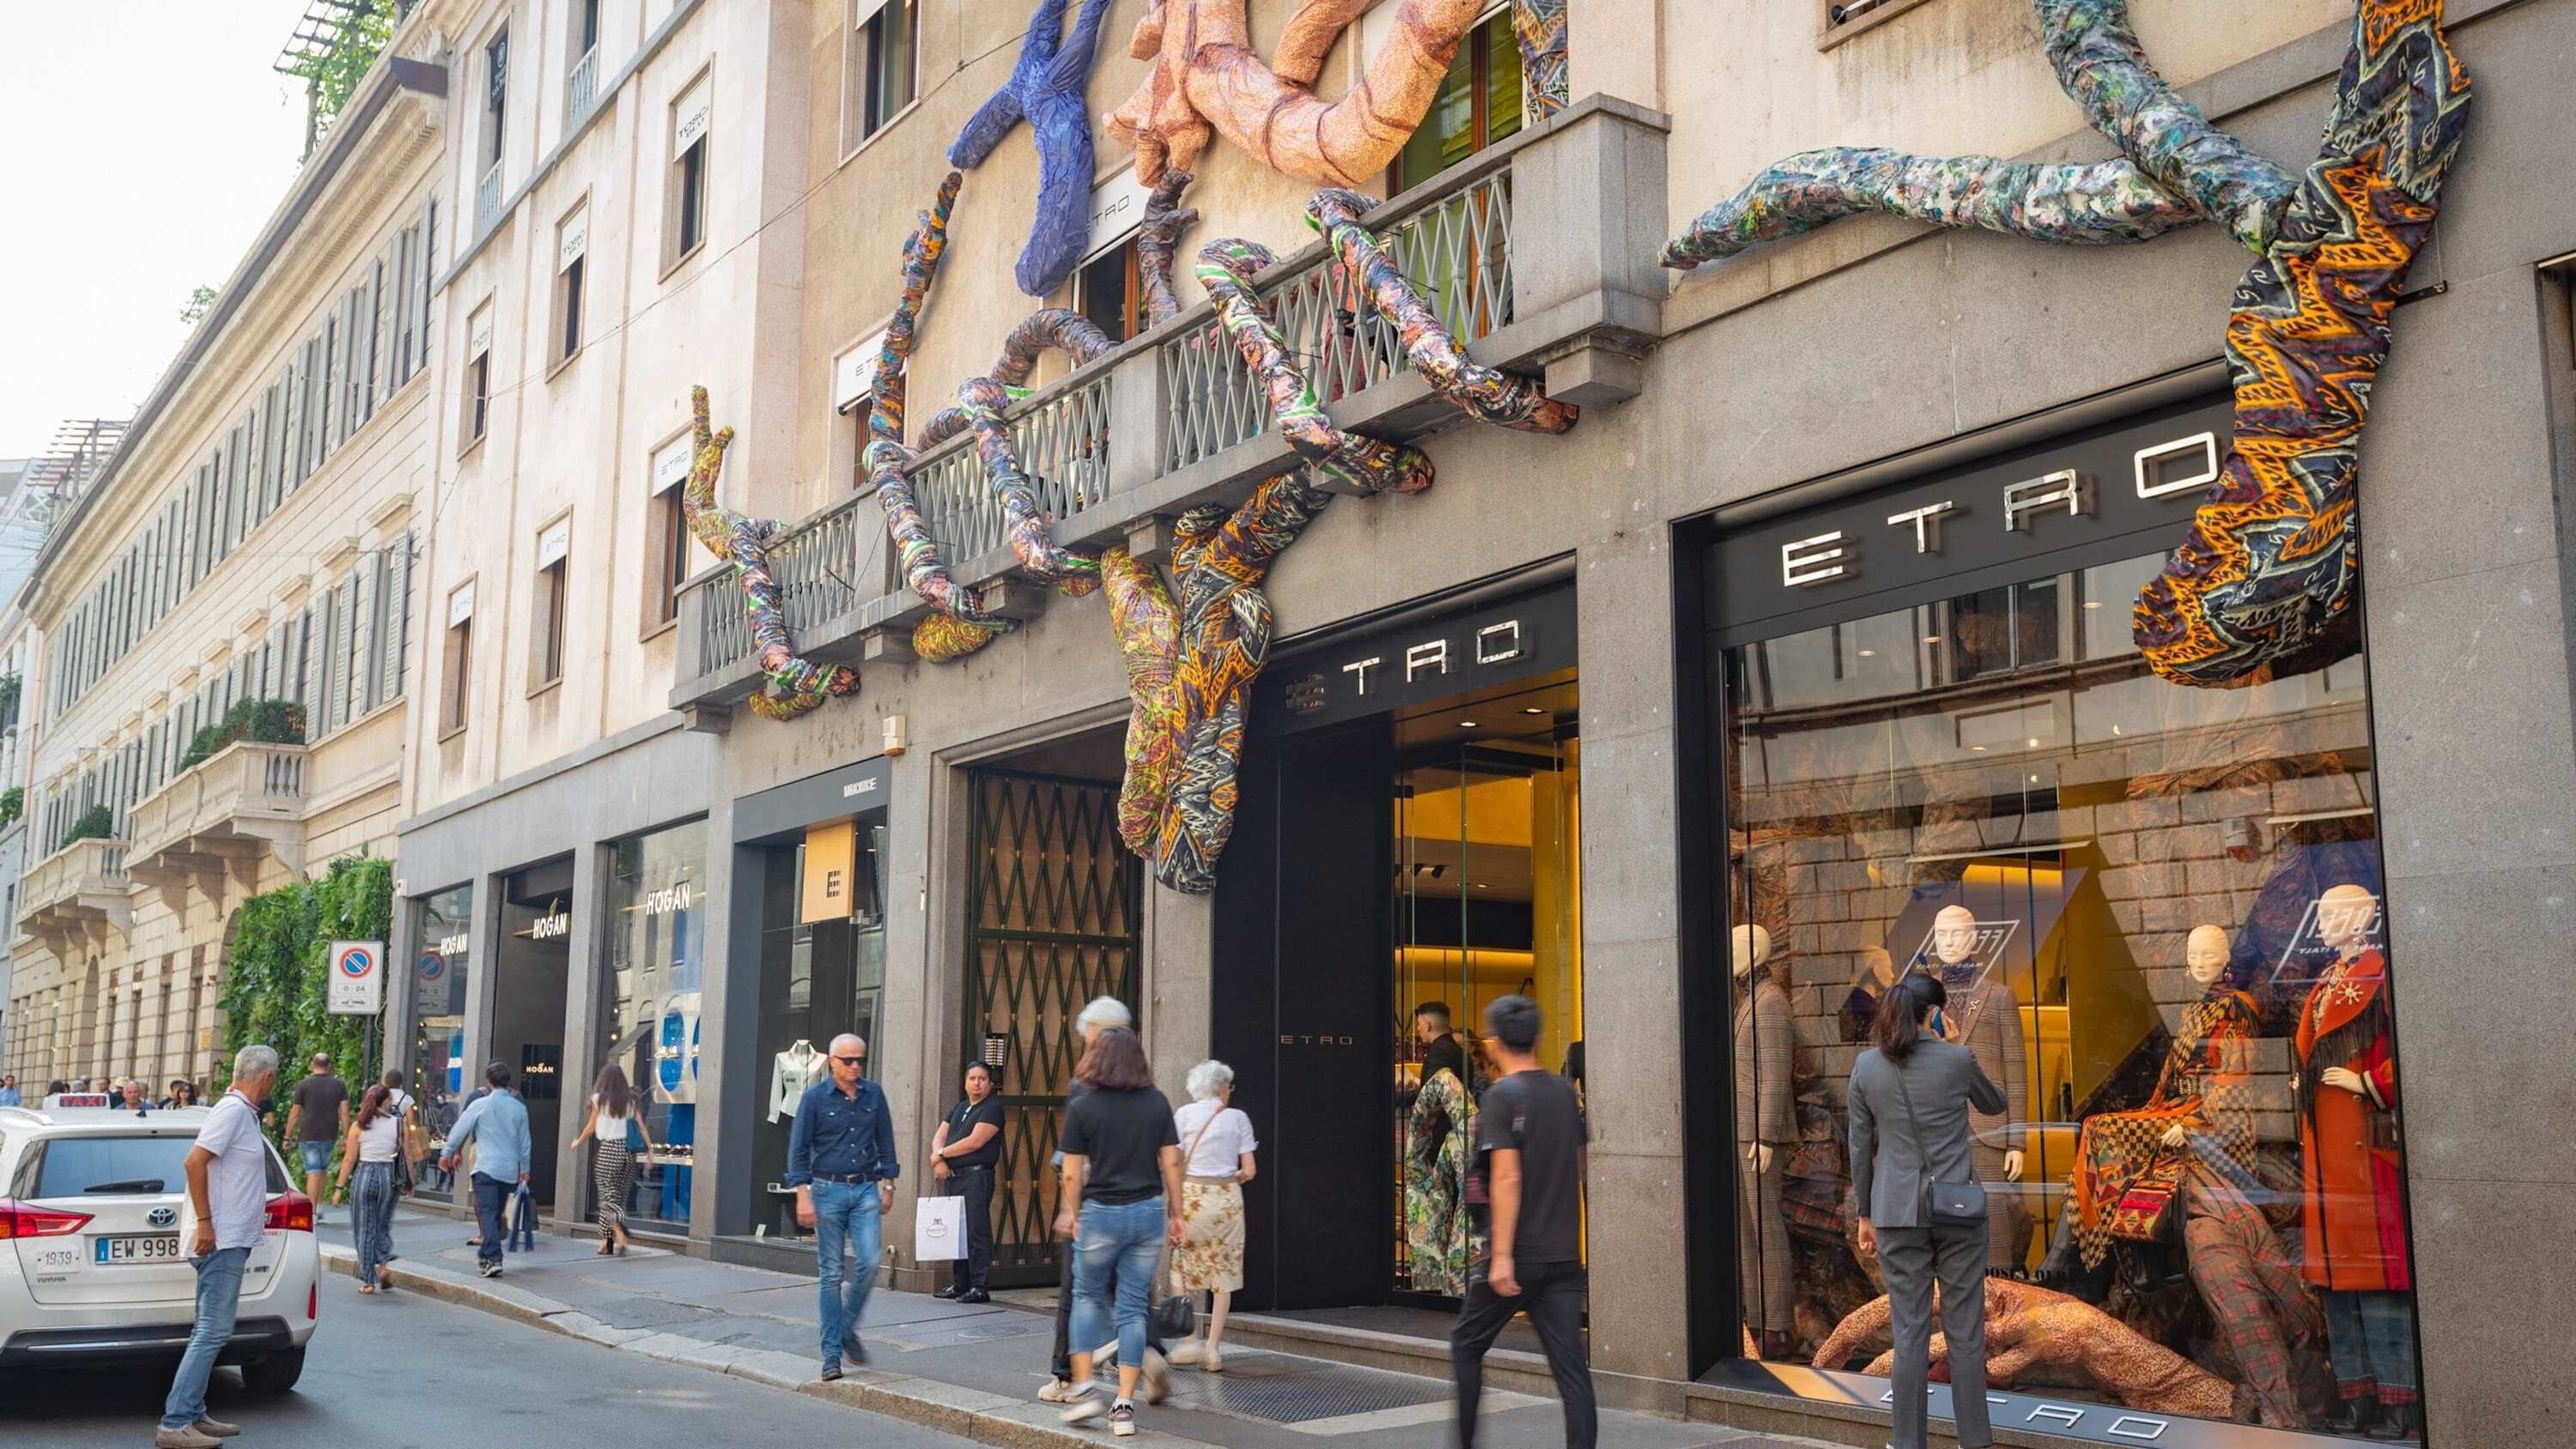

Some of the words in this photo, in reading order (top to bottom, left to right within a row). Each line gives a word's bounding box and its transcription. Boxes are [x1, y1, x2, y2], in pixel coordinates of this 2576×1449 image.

[1086, 194, 1130, 233] TRO
[1782, 431, 2218, 587] ETRO
[1285, 619, 1520, 711] ETRO
[646, 884, 690, 916] HOGAN
[532, 912, 568, 940] HOGAN
[440, 933, 468, 957] HOGAN
[1279, 1034, 1352, 1045] ETRO
[526, 1065, 554, 1074] HOGAN
[62, 1095, 105, 1107] TAXI
[45, 1251, 73, 1265] 1939
[112, 1240, 135, 1259] EW
[143, 1239, 179, 1258] 998
[1880, 1387, 2169, 1440] RO
